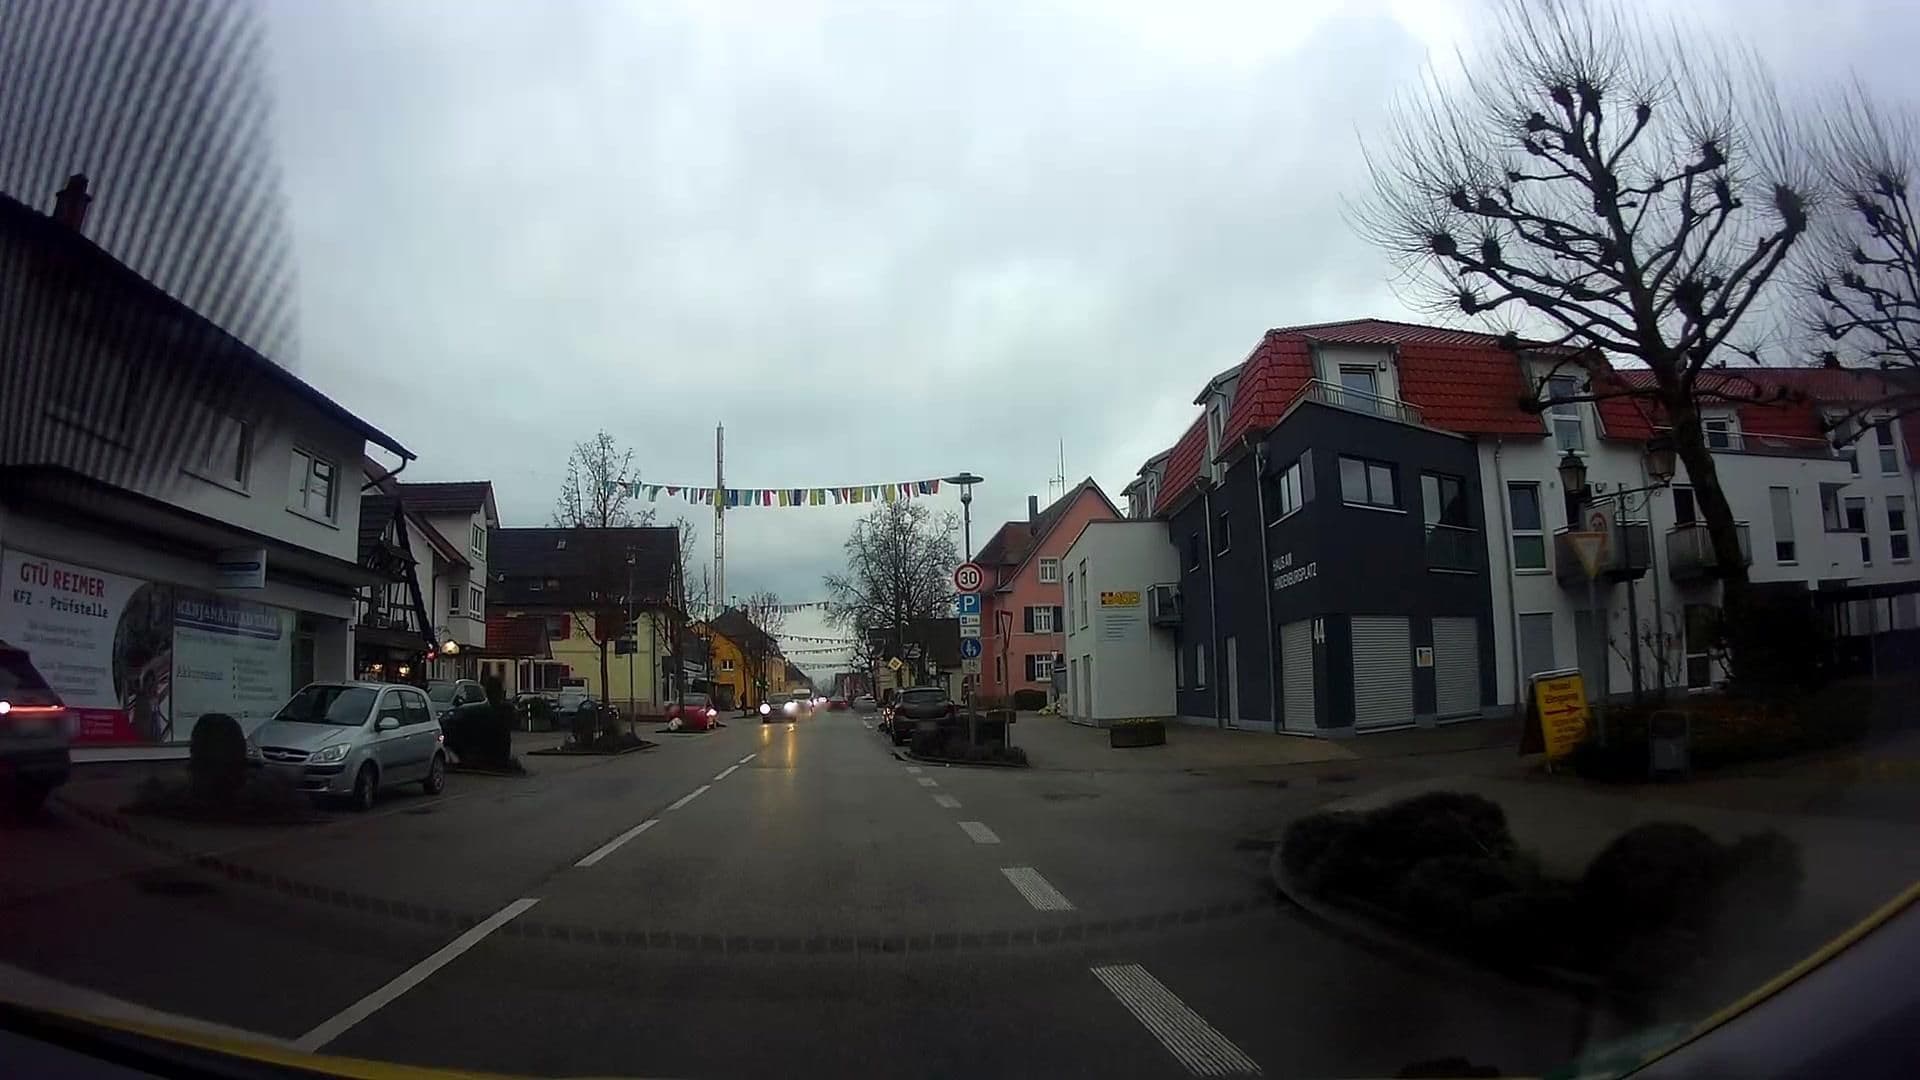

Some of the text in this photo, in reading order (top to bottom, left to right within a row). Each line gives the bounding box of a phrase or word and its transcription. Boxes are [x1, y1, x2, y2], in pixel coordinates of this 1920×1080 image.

[21, 563, 105, 598] GTÜ REIMER
[960, 571, 978, 585] 30
[13, 589, 33, 606] KFZ
[50, 597, 109, 618] Prüfstelle
[964, 596, 975, 612] P
[1313, 617, 1325, 645] 44
